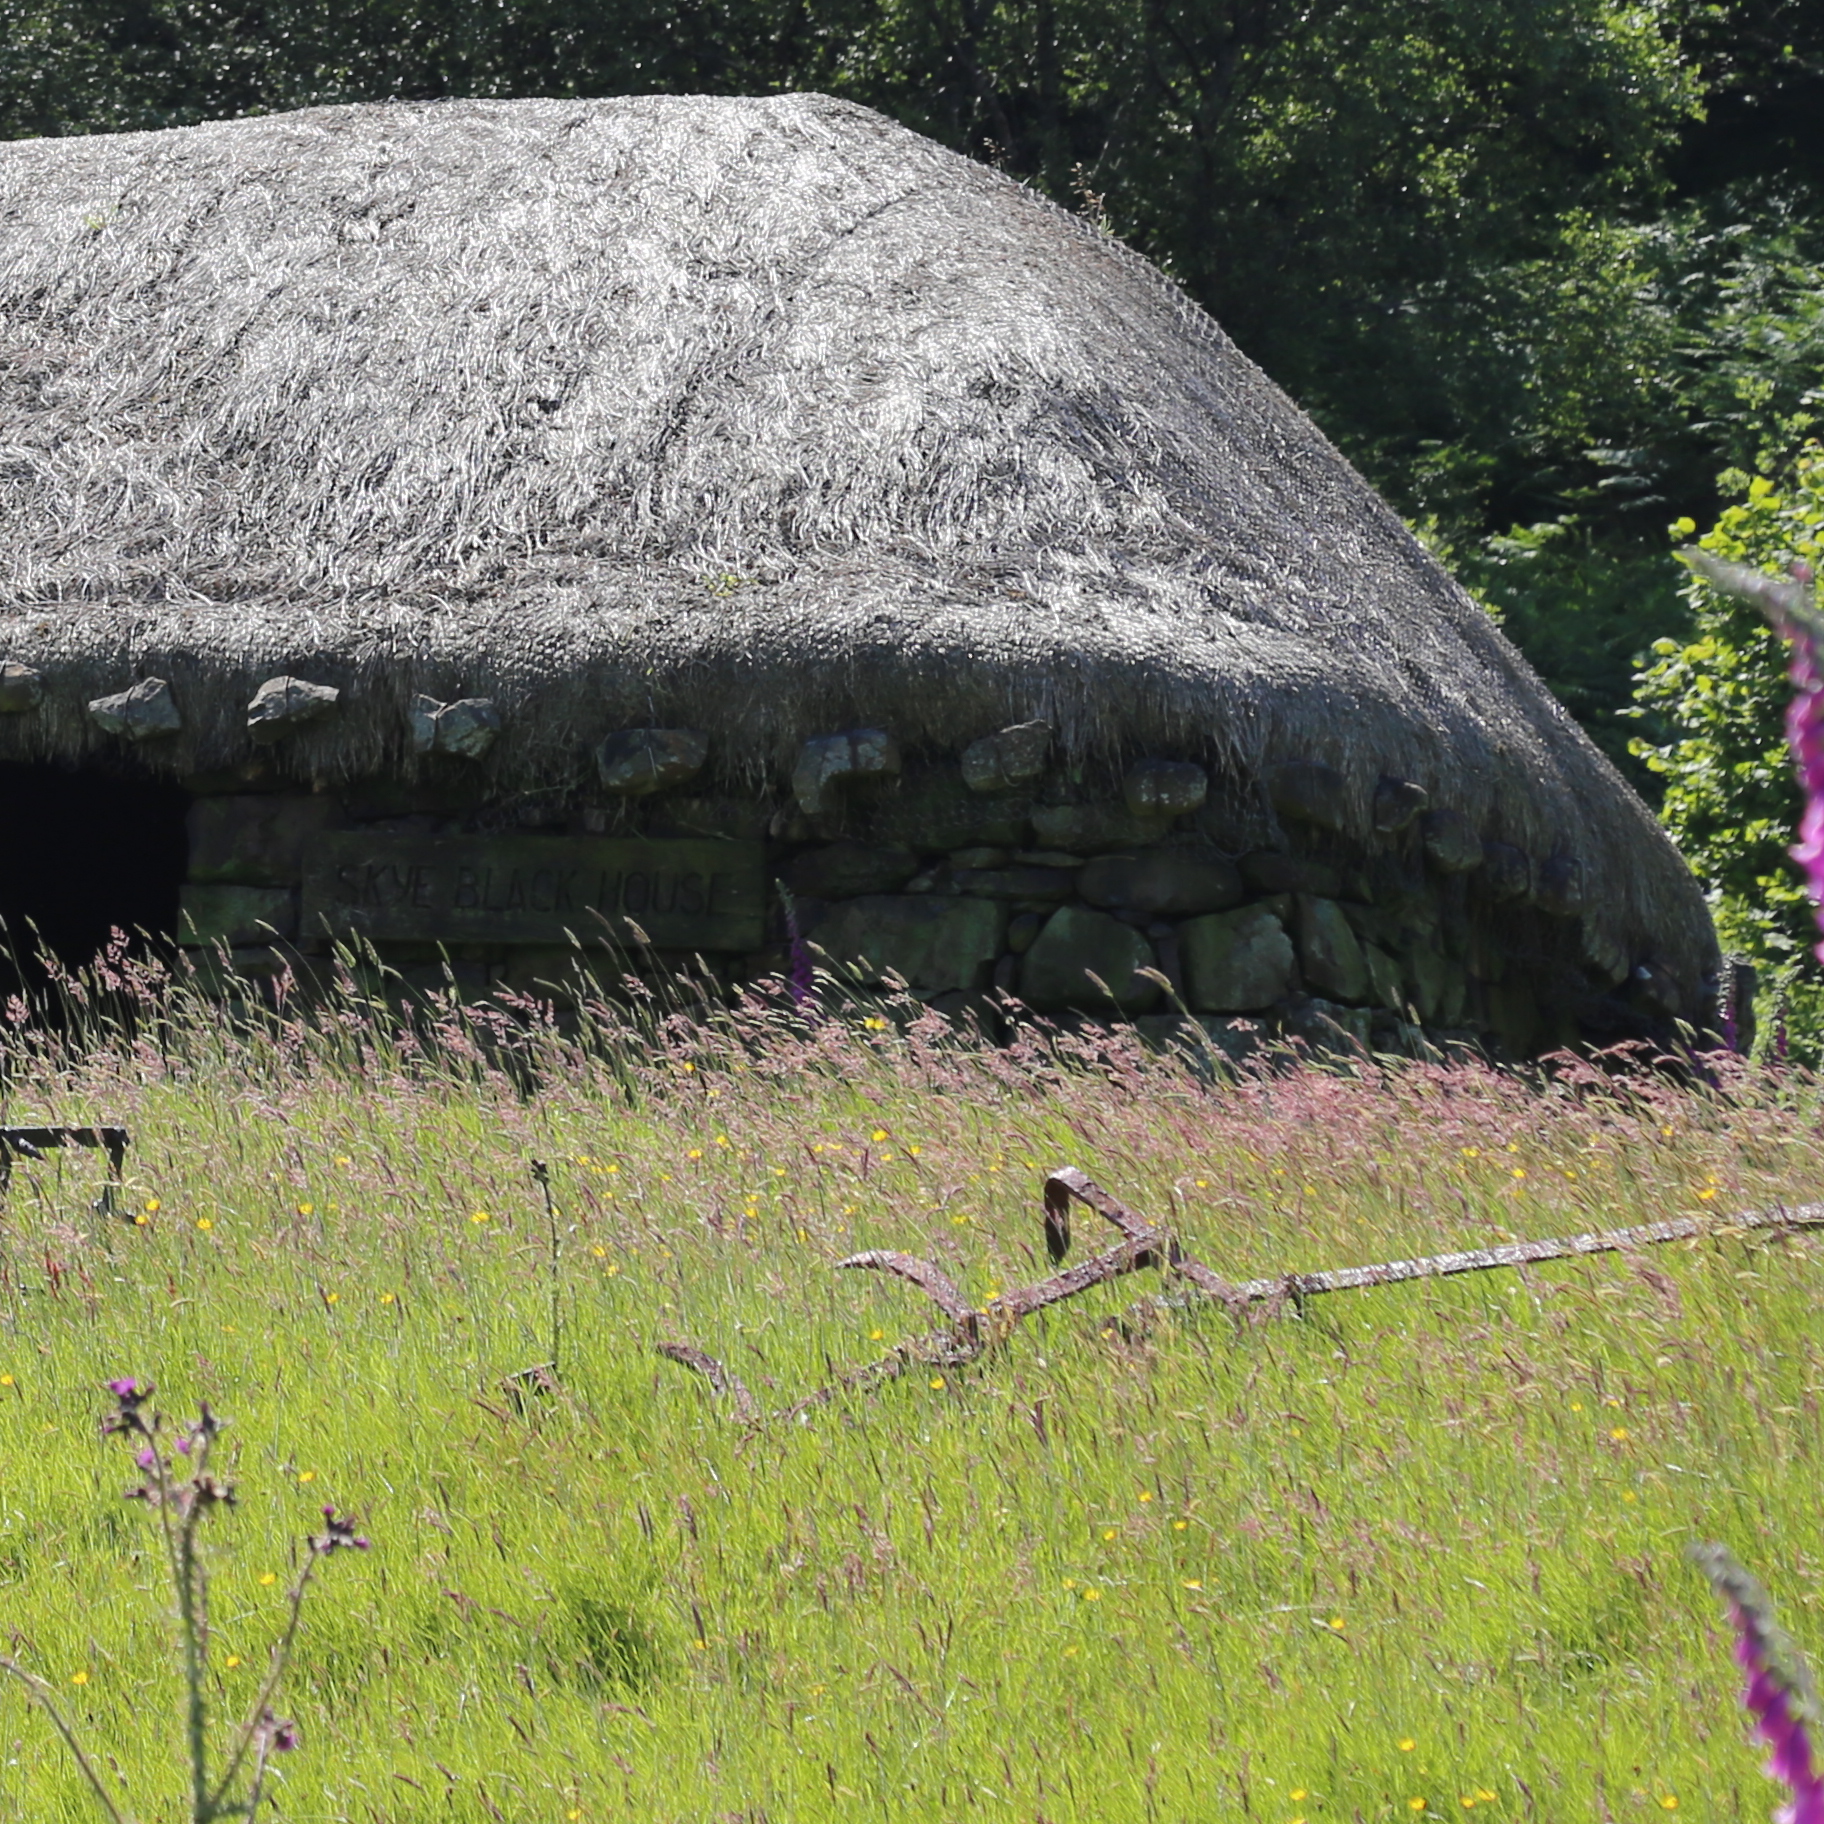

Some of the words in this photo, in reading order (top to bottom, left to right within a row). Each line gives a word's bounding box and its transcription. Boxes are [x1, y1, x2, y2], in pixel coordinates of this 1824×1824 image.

[335, 864, 436, 909] SKYE
[454, 866, 578, 912] BLACK
[598, 870, 733, 917] HOUSE
